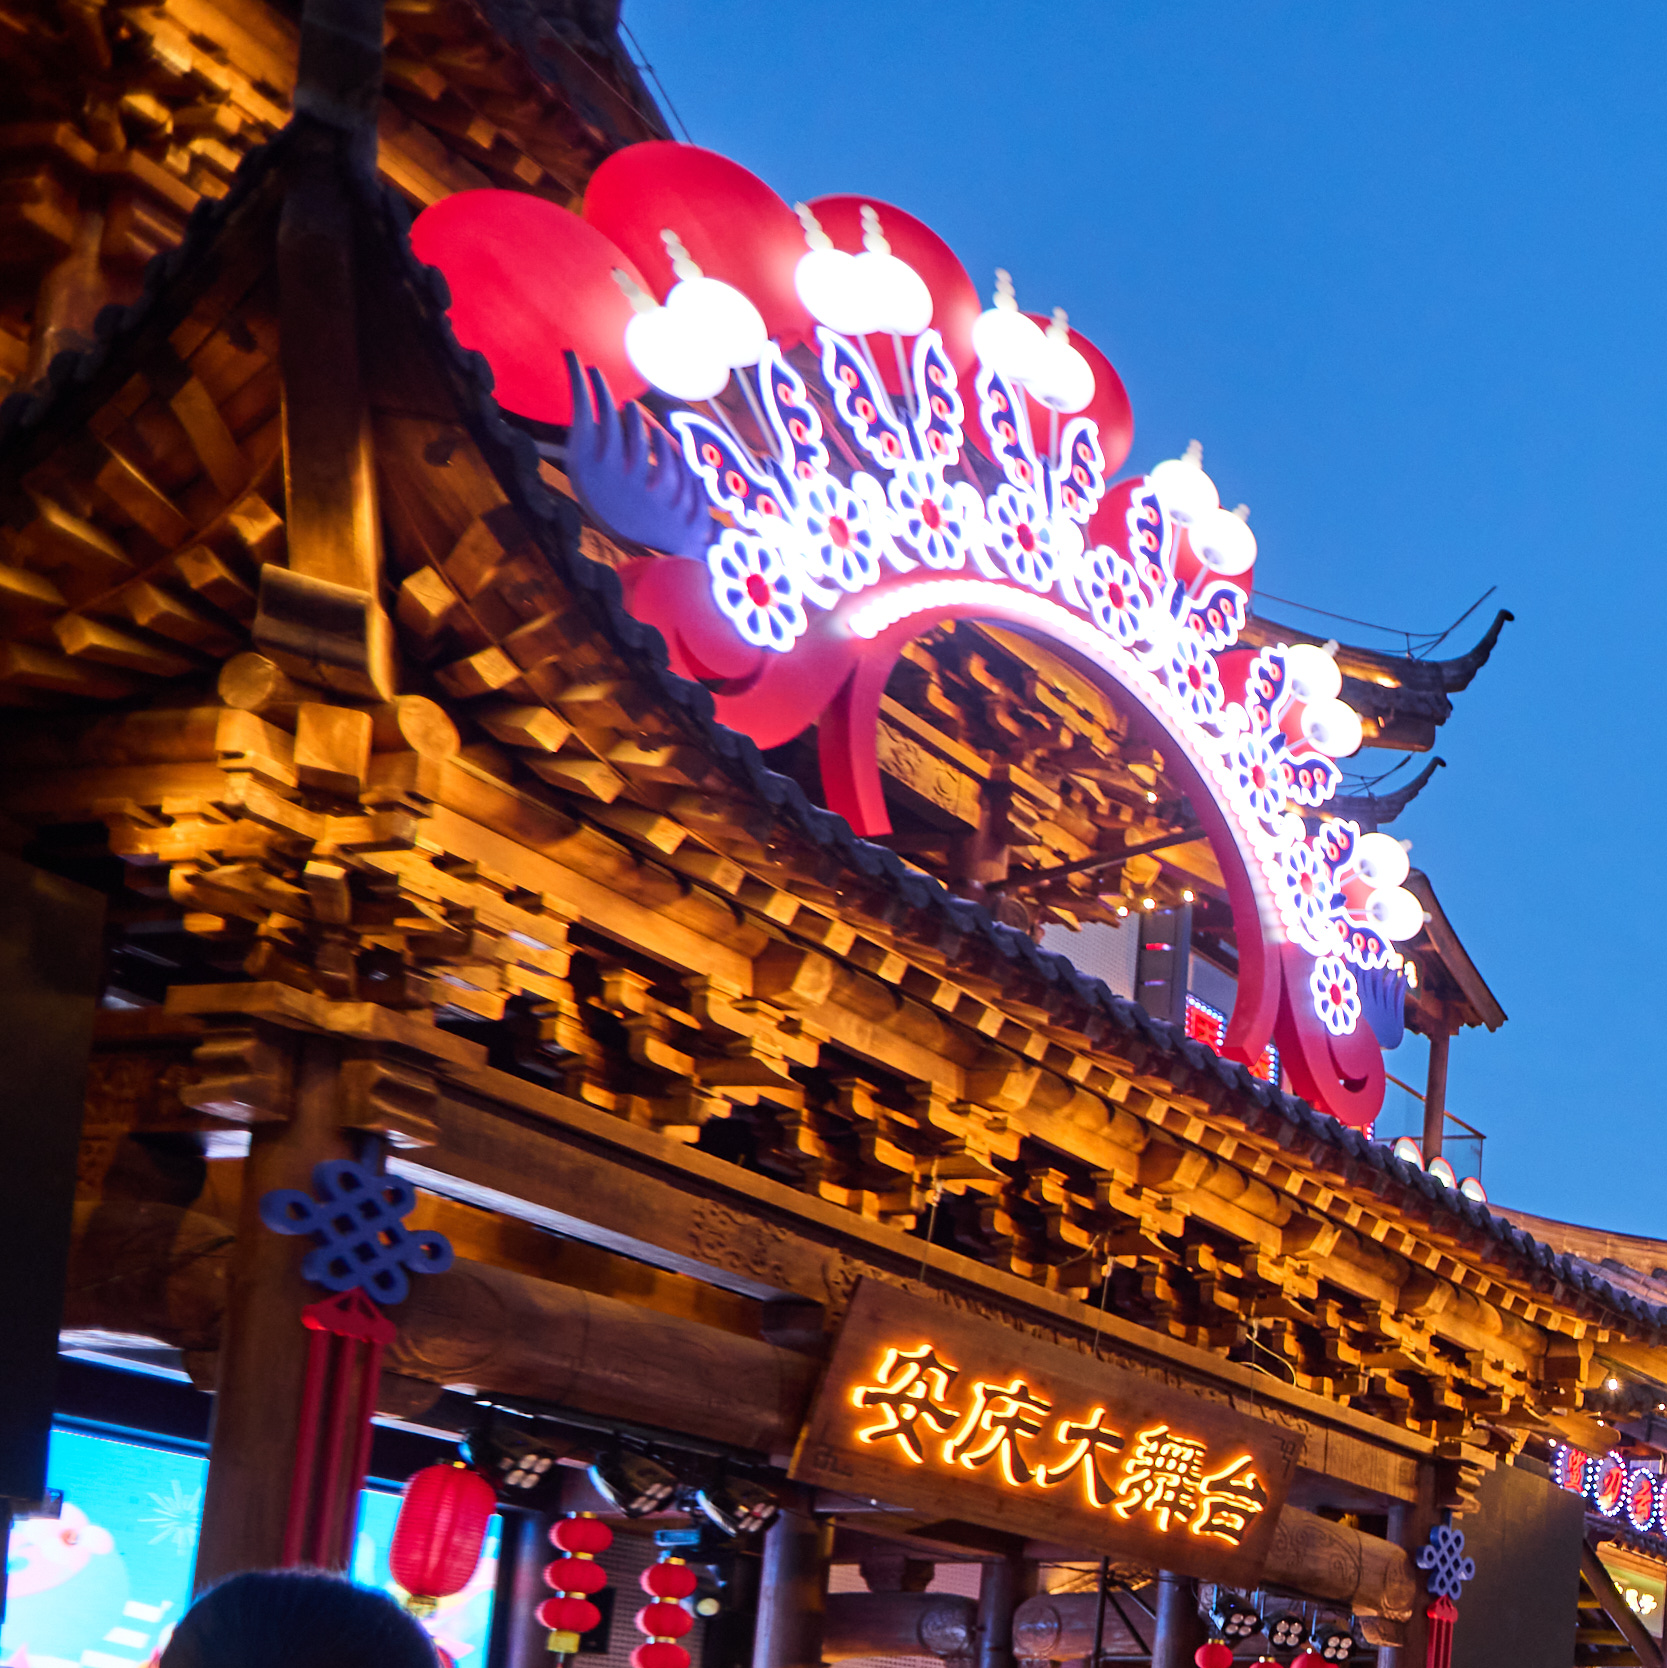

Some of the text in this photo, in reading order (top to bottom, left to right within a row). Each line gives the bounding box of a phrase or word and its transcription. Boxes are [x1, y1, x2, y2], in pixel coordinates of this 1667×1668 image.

[854, 1343, 1268, 1546] 安庆大舞台
